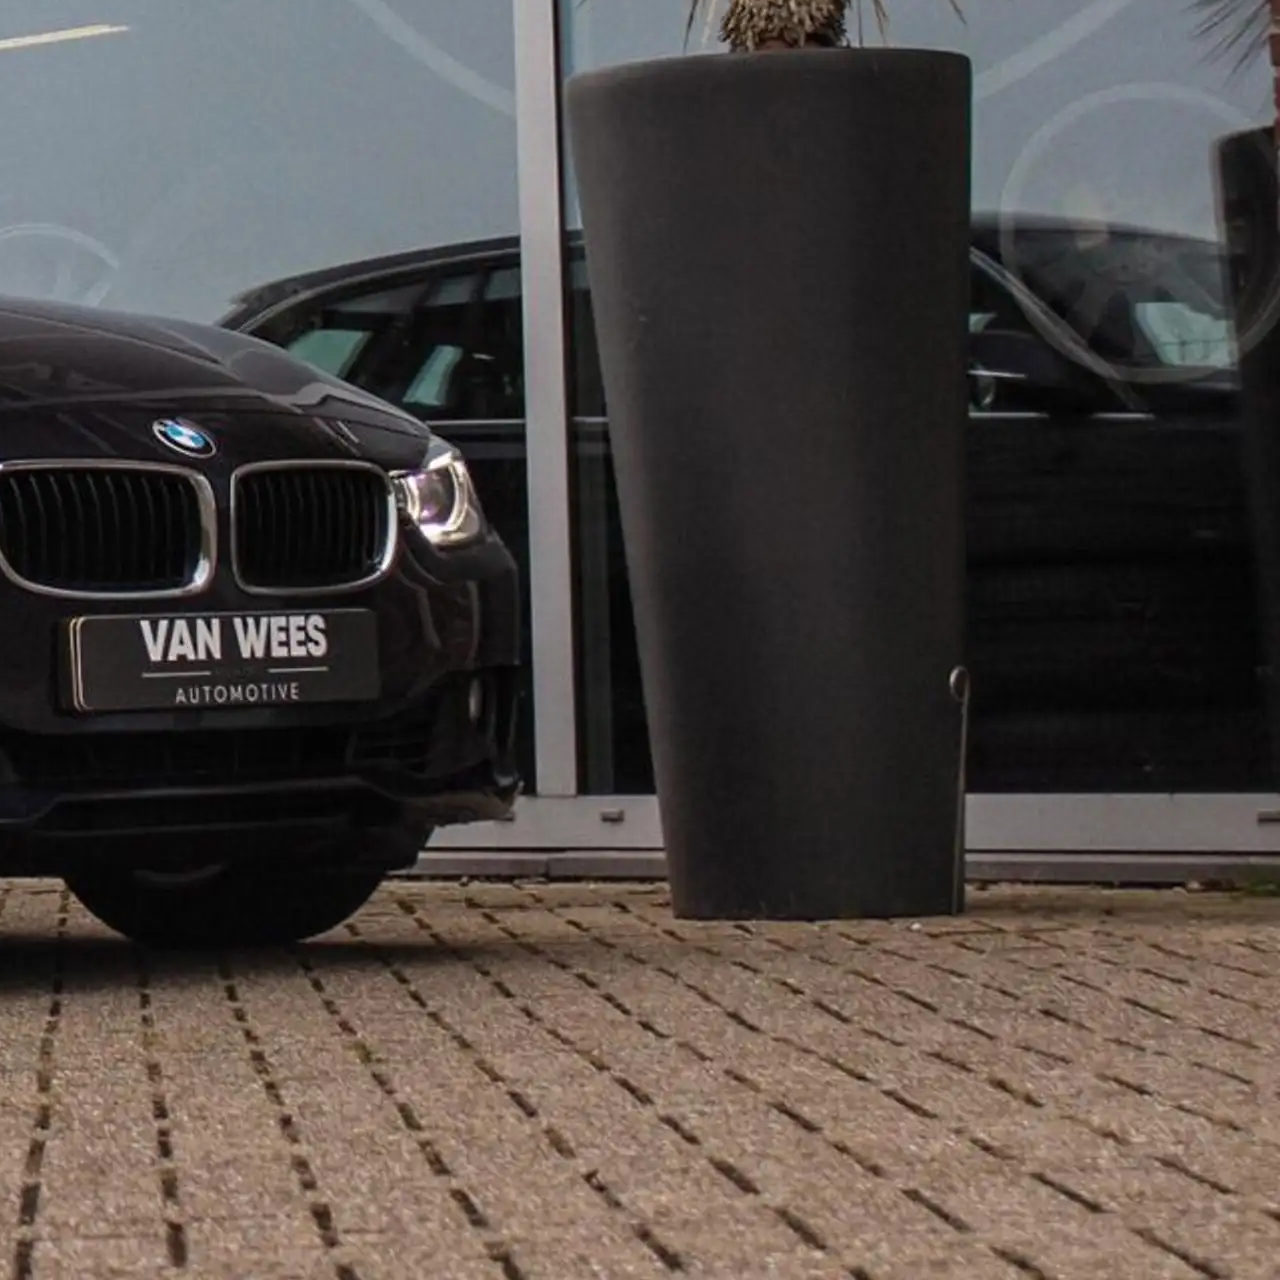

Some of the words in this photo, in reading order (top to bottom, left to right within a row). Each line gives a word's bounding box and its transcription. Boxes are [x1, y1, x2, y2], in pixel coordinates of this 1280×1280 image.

[140, 619, 222, 661] VAN
[234, 615, 328, 658] WEES
[175, 682, 300, 704] AUTOMOTIVE
